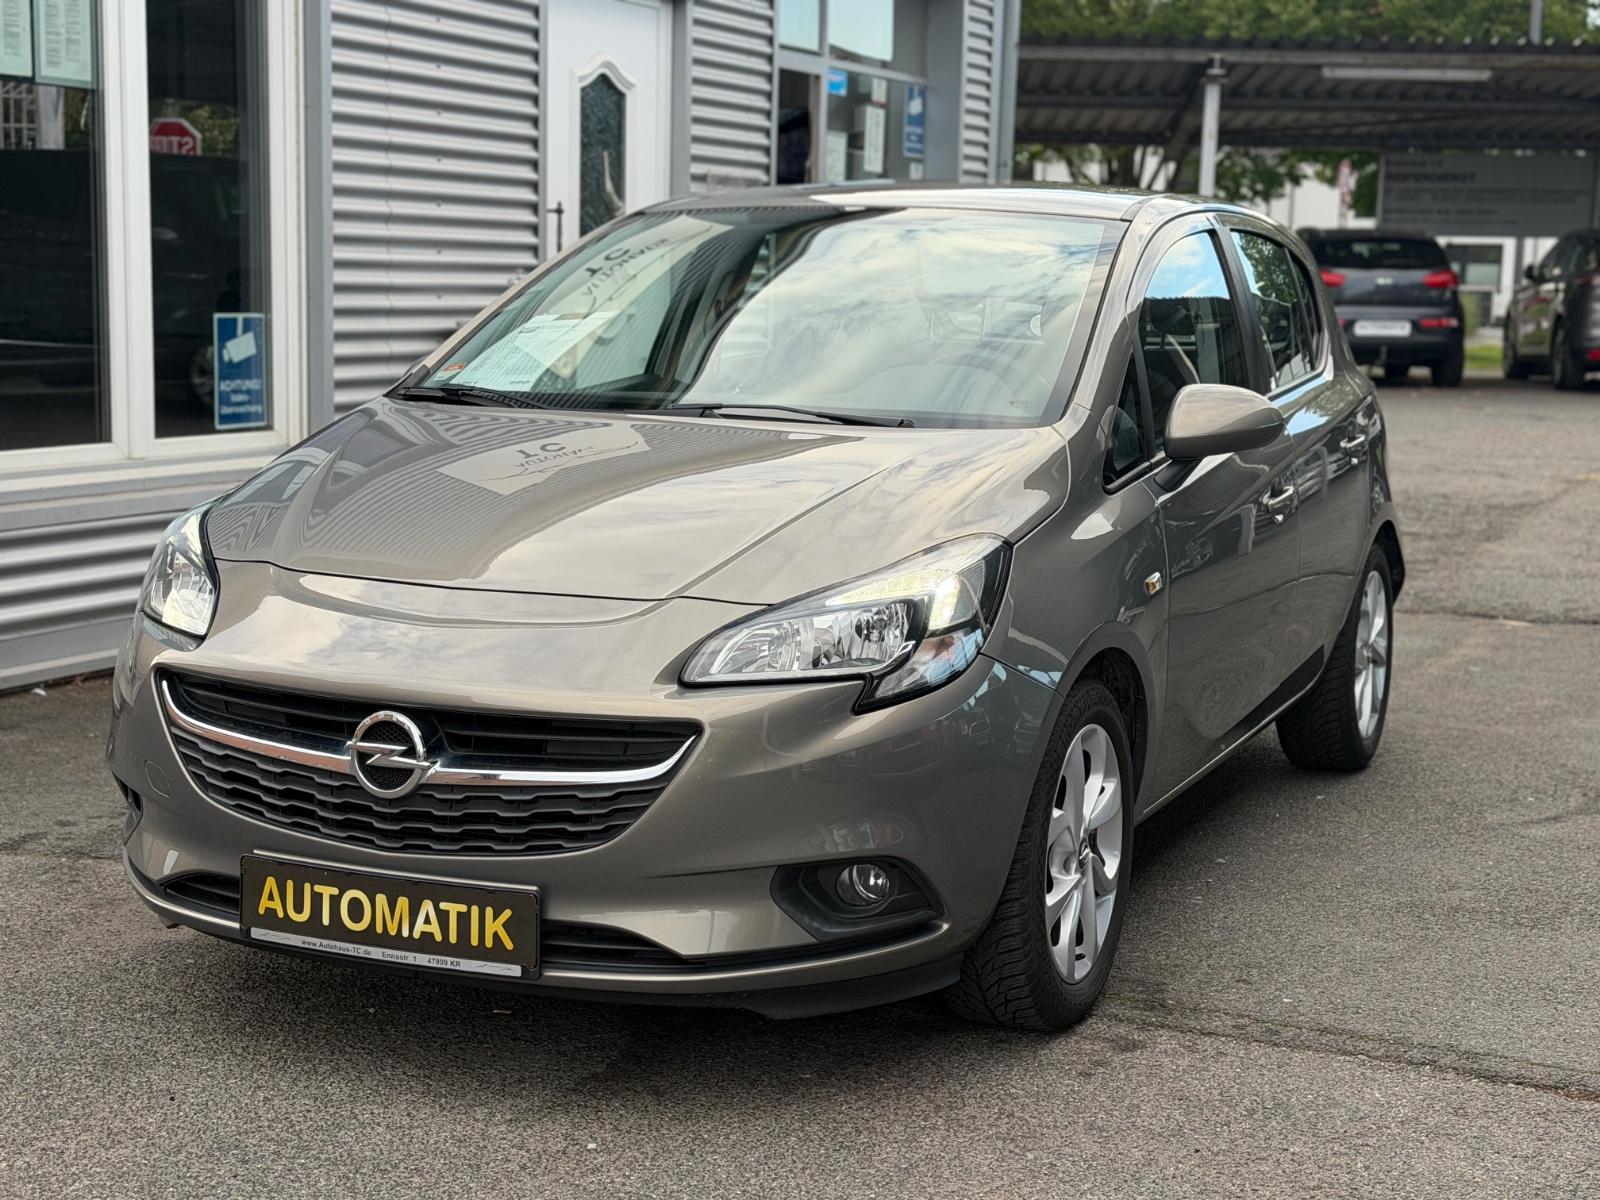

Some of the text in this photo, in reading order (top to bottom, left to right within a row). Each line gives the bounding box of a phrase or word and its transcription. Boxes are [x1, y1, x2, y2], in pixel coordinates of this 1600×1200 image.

[258, 876, 514, 950] AUTOMATIK
[301, 939, 372, 957] www.Autohaus-TC.de
[427, 957, 449, 966] 47809
